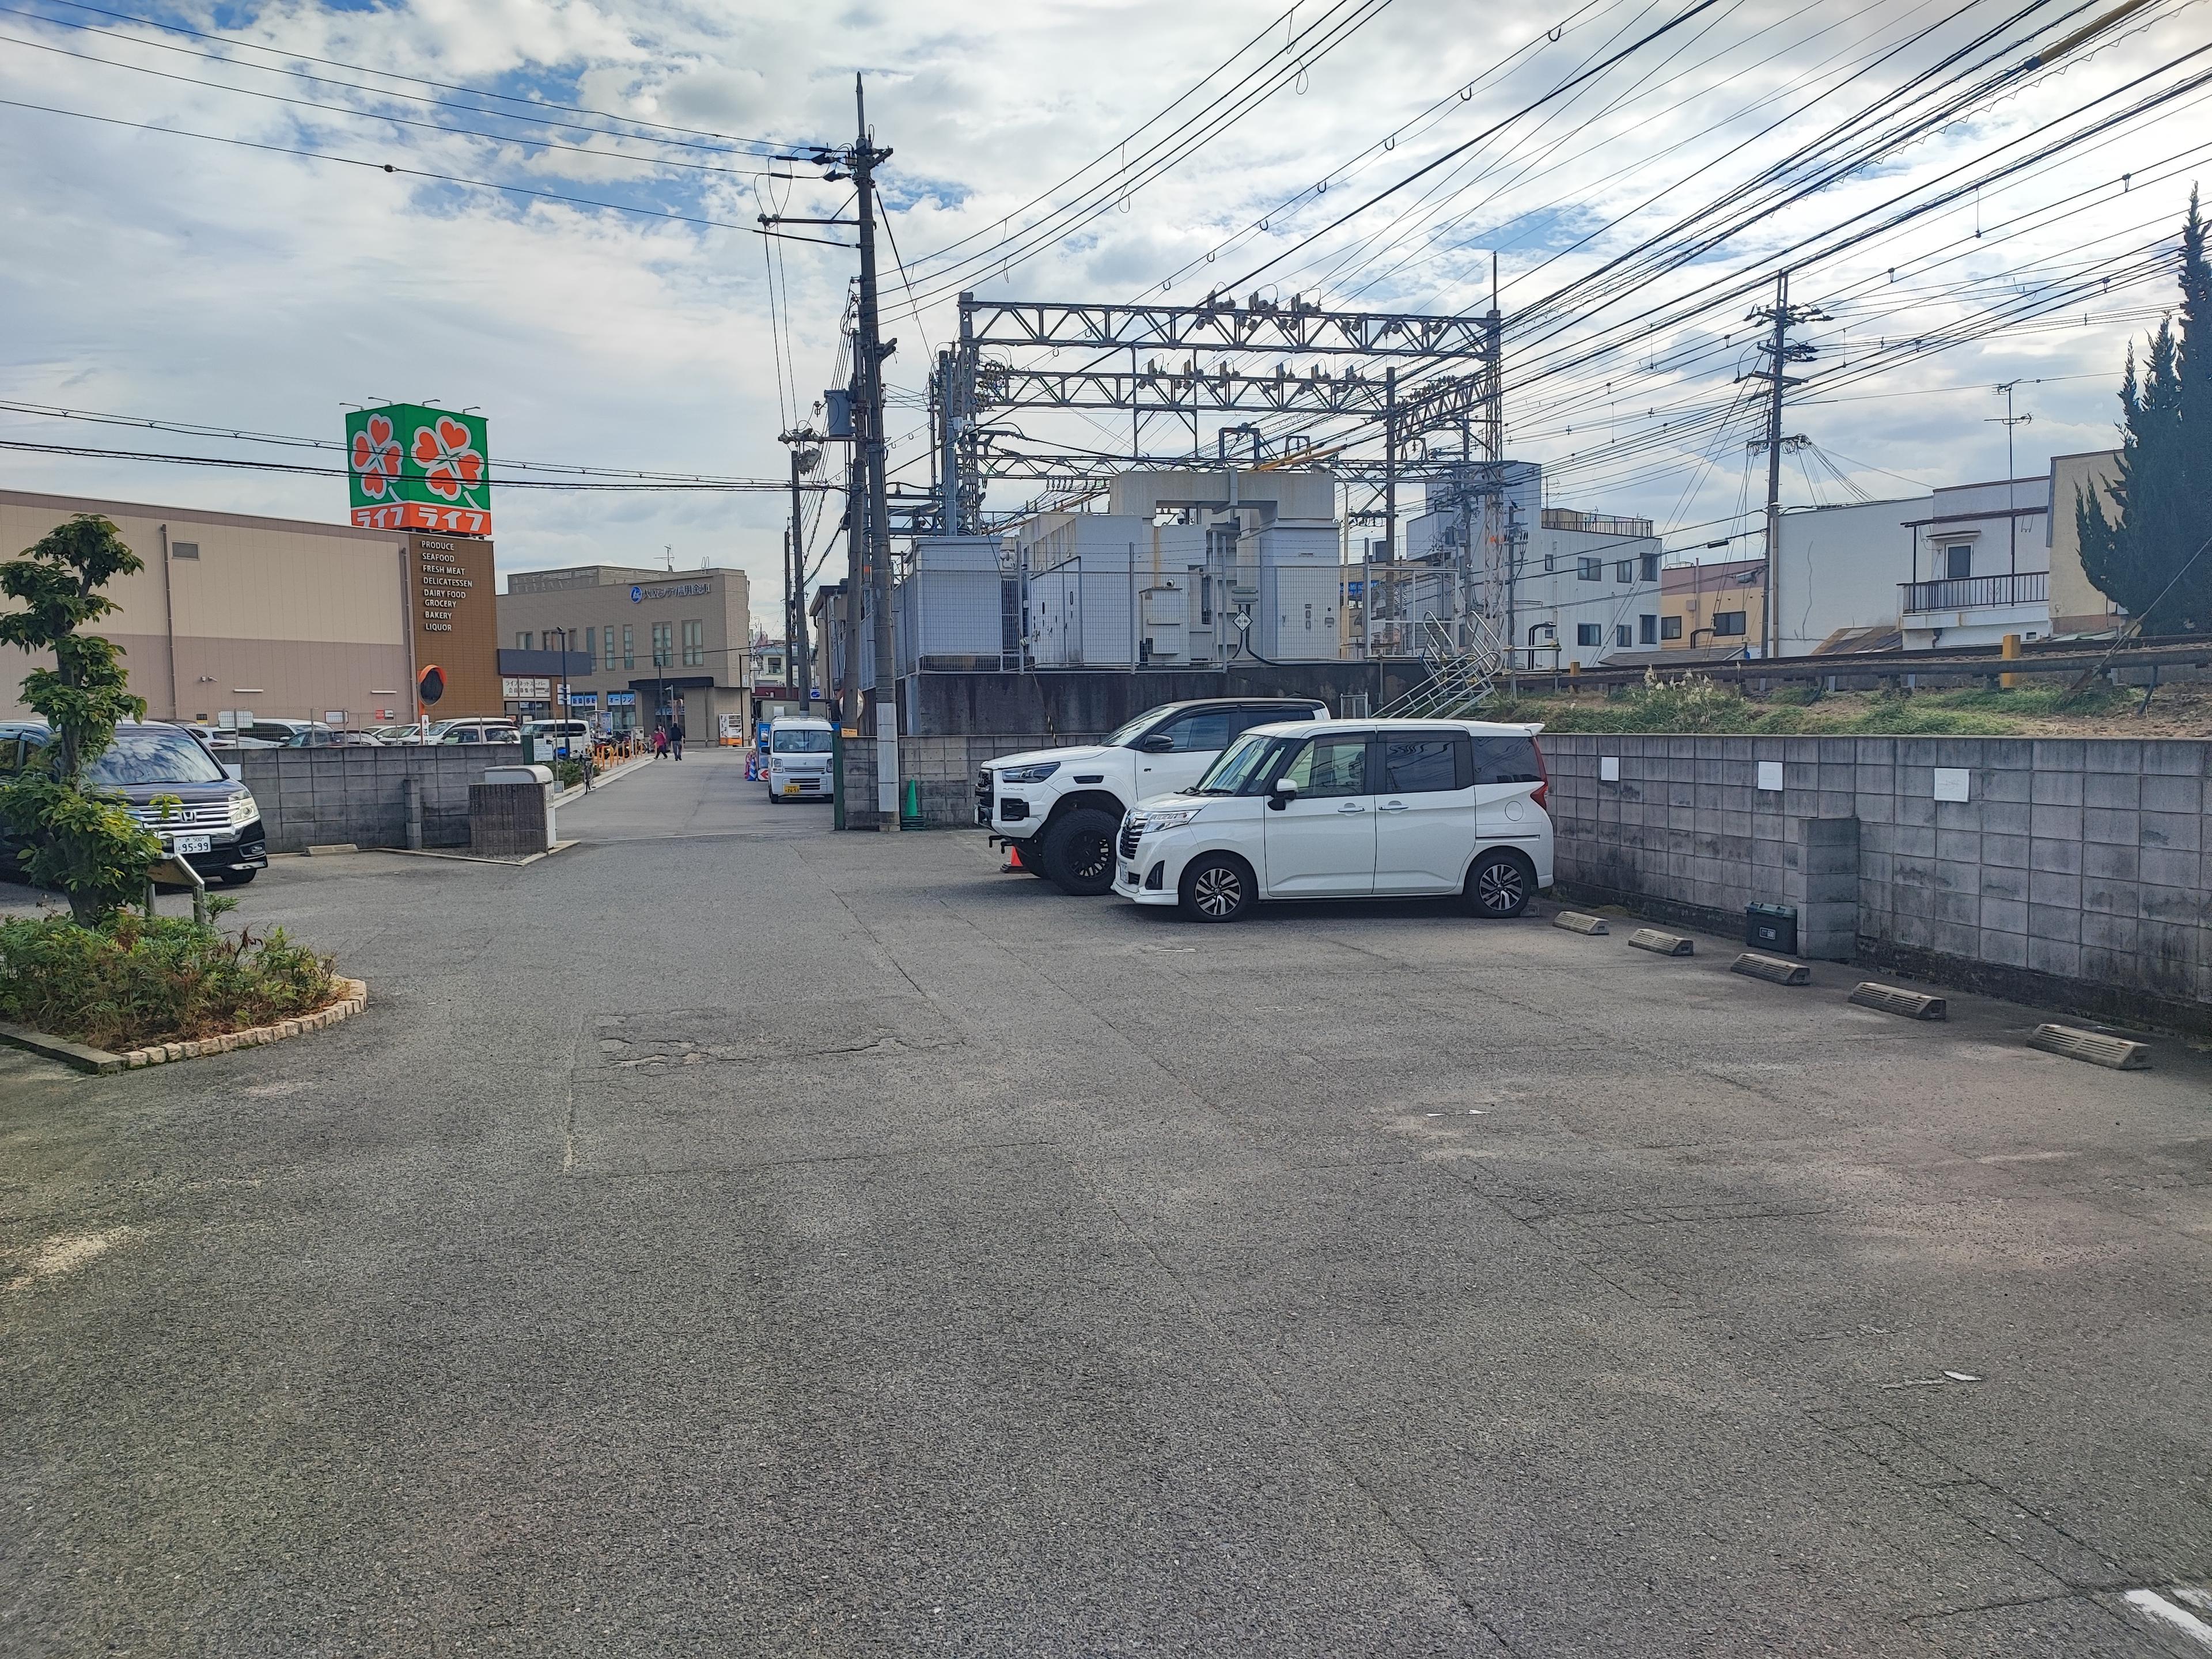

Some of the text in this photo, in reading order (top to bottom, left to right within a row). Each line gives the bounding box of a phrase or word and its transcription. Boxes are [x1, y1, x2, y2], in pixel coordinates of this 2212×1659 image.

[357, 506, 404, 528] ライフ
[419, 507, 483, 532] ライフ
[422, 540, 454, 551] PRODUCE
[422, 552, 454, 562] SEAFOOD
[423, 565, 465, 575] FRESH MEAT
[423, 577, 472, 588] DELICATESSEN
[424, 589, 466, 599] DAIRY FOOD
[425, 599, 457, 608] GROCERY
[425, 611, 452, 620] BAKERY
[426, 623, 452, 631] LIQUOR
[182, 842, 209, 852] 95-99
